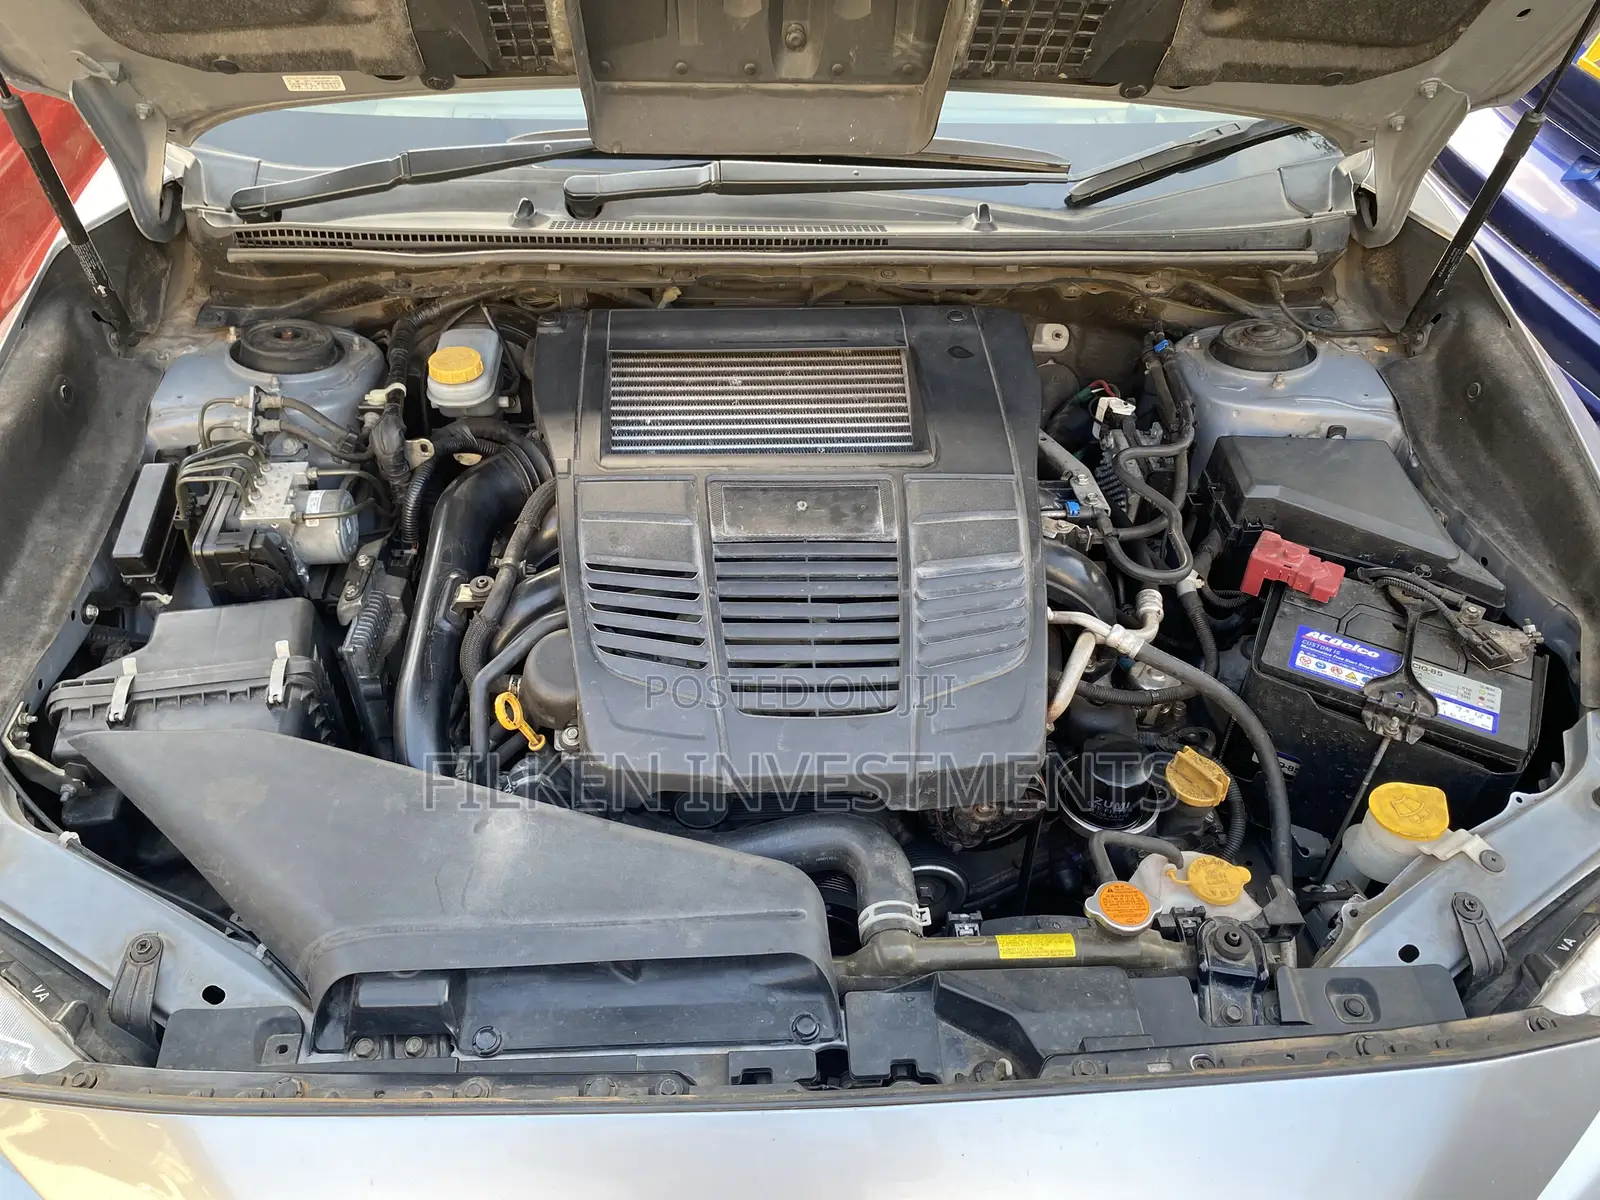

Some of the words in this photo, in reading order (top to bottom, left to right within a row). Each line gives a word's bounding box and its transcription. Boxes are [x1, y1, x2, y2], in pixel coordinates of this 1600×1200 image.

[1301, 640, 1333, 653] CUSTOM
[1304, 631, 1380, 658] ACDelco
[1556, 938, 1577, 951] VA
[31, 984, 50, 1003] VA
